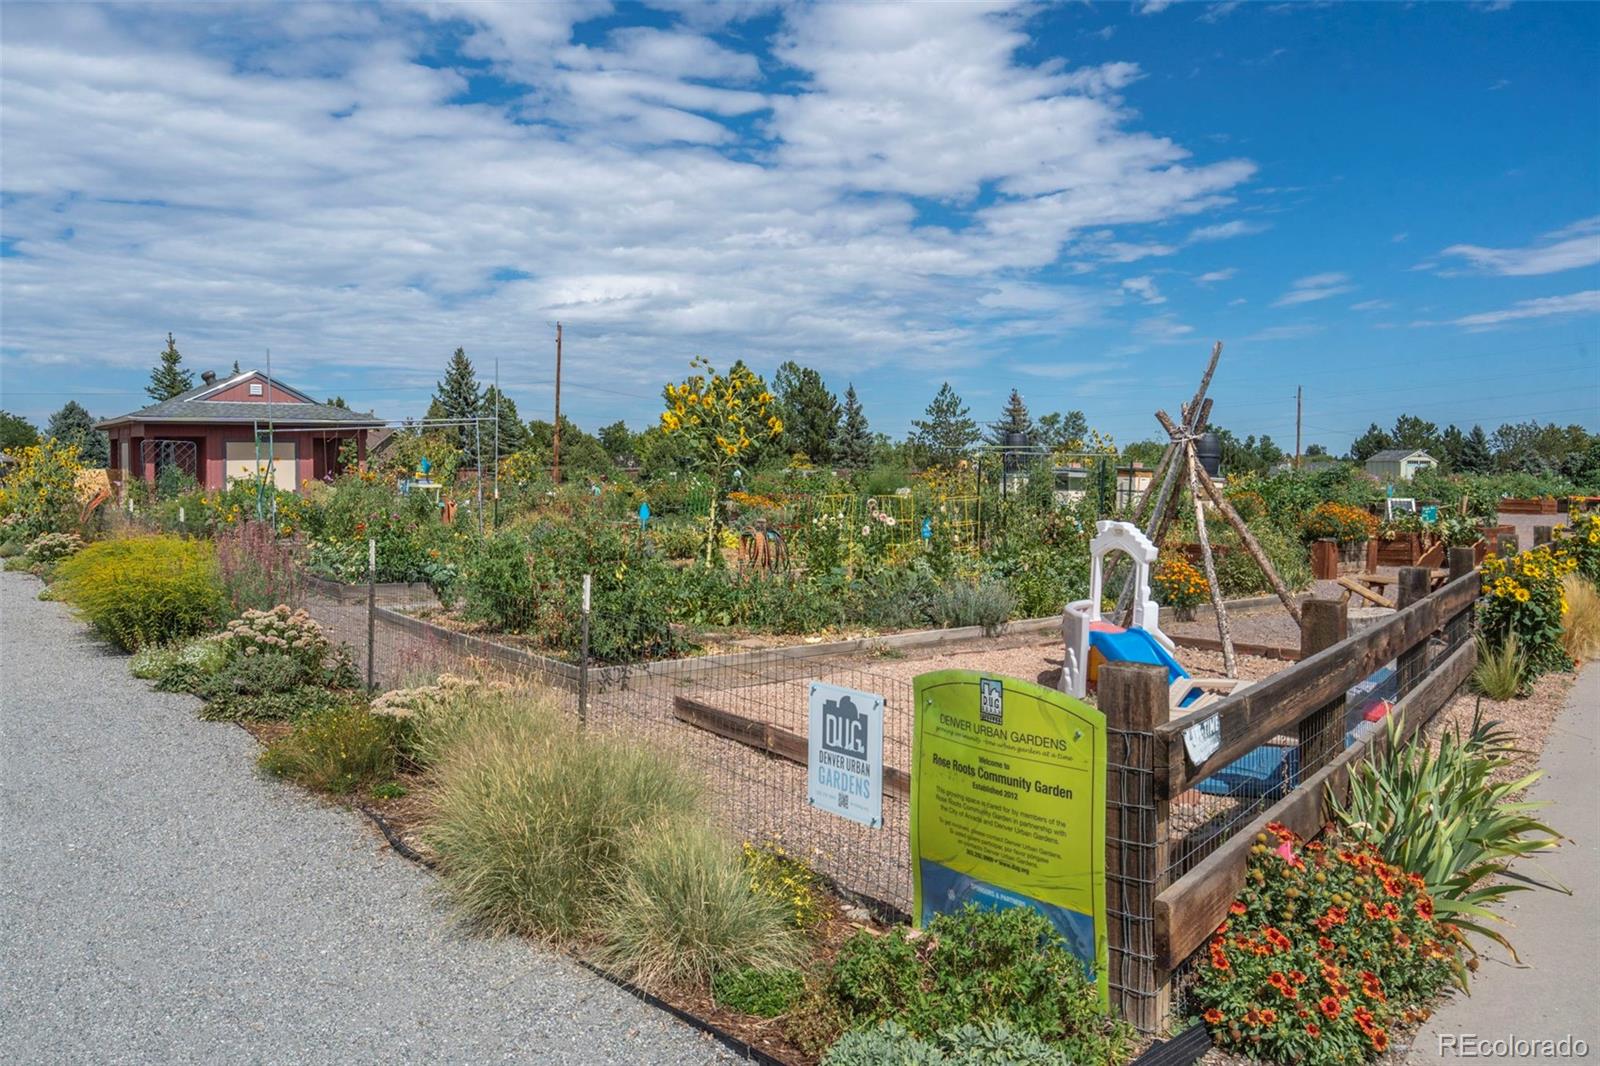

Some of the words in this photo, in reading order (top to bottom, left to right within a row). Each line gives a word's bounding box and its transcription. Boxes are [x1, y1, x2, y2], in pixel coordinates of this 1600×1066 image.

[983, 695, 1000, 709] DUG
[939, 713, 972, 732] DENVER
[973, 723, 1008, 741] URBAN
[1010, 731, 1068, 751] GARDENS
[819, 750, 845, 770] DENVER
[846, 756, 871, 778] URBAN
[978, 755, 1003, 769] Welcome
[1003, 761, 1011, 771] to
[818, 766, 871, 799] GARDENS
[932, 752, 952, 769] Rose
[952, 758, 976, 777] Roots
[977, 766, 1033, 793] Community
[1034, 780, 1074, 800] Garden
[1003, 789, 1019, 801] 2012
[1011, 808, 1019, 817] by
[1055, 819, 1067, 828] the
[1019, 820, 1053, 835] partnership
[994, 820, 1013, 832] Denver
[1014, 826, 1032, 838] Urban
